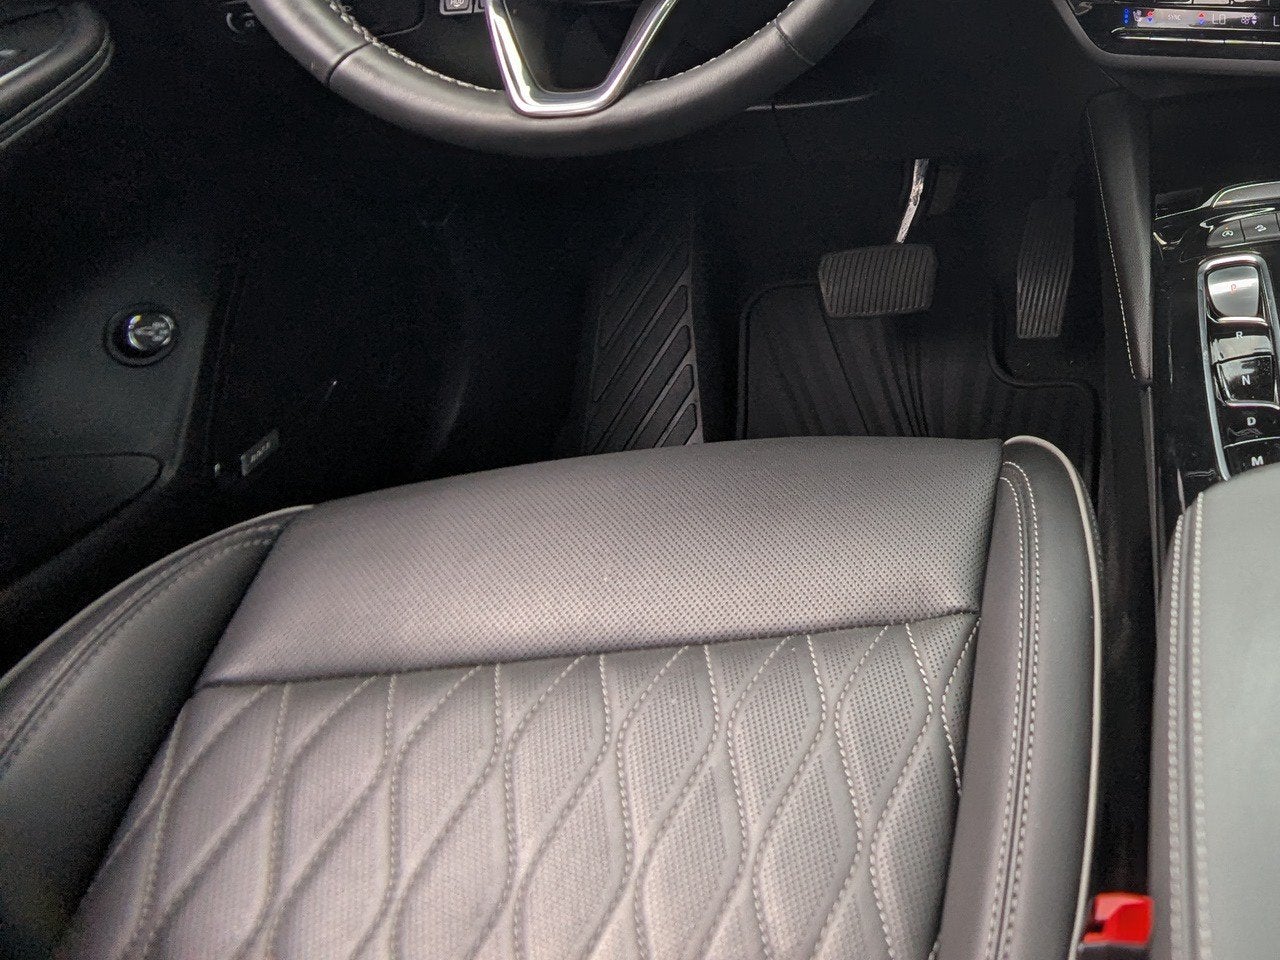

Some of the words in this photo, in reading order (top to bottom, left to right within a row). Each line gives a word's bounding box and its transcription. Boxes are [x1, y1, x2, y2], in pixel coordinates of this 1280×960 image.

[1230, 283, 1237, 294] P
[1236, 331, 1243, 339] R
[1241, 375, 1251, 386] N
[1246, 416, 1256, 426] D
[1251, 455, 1264, 467] M
